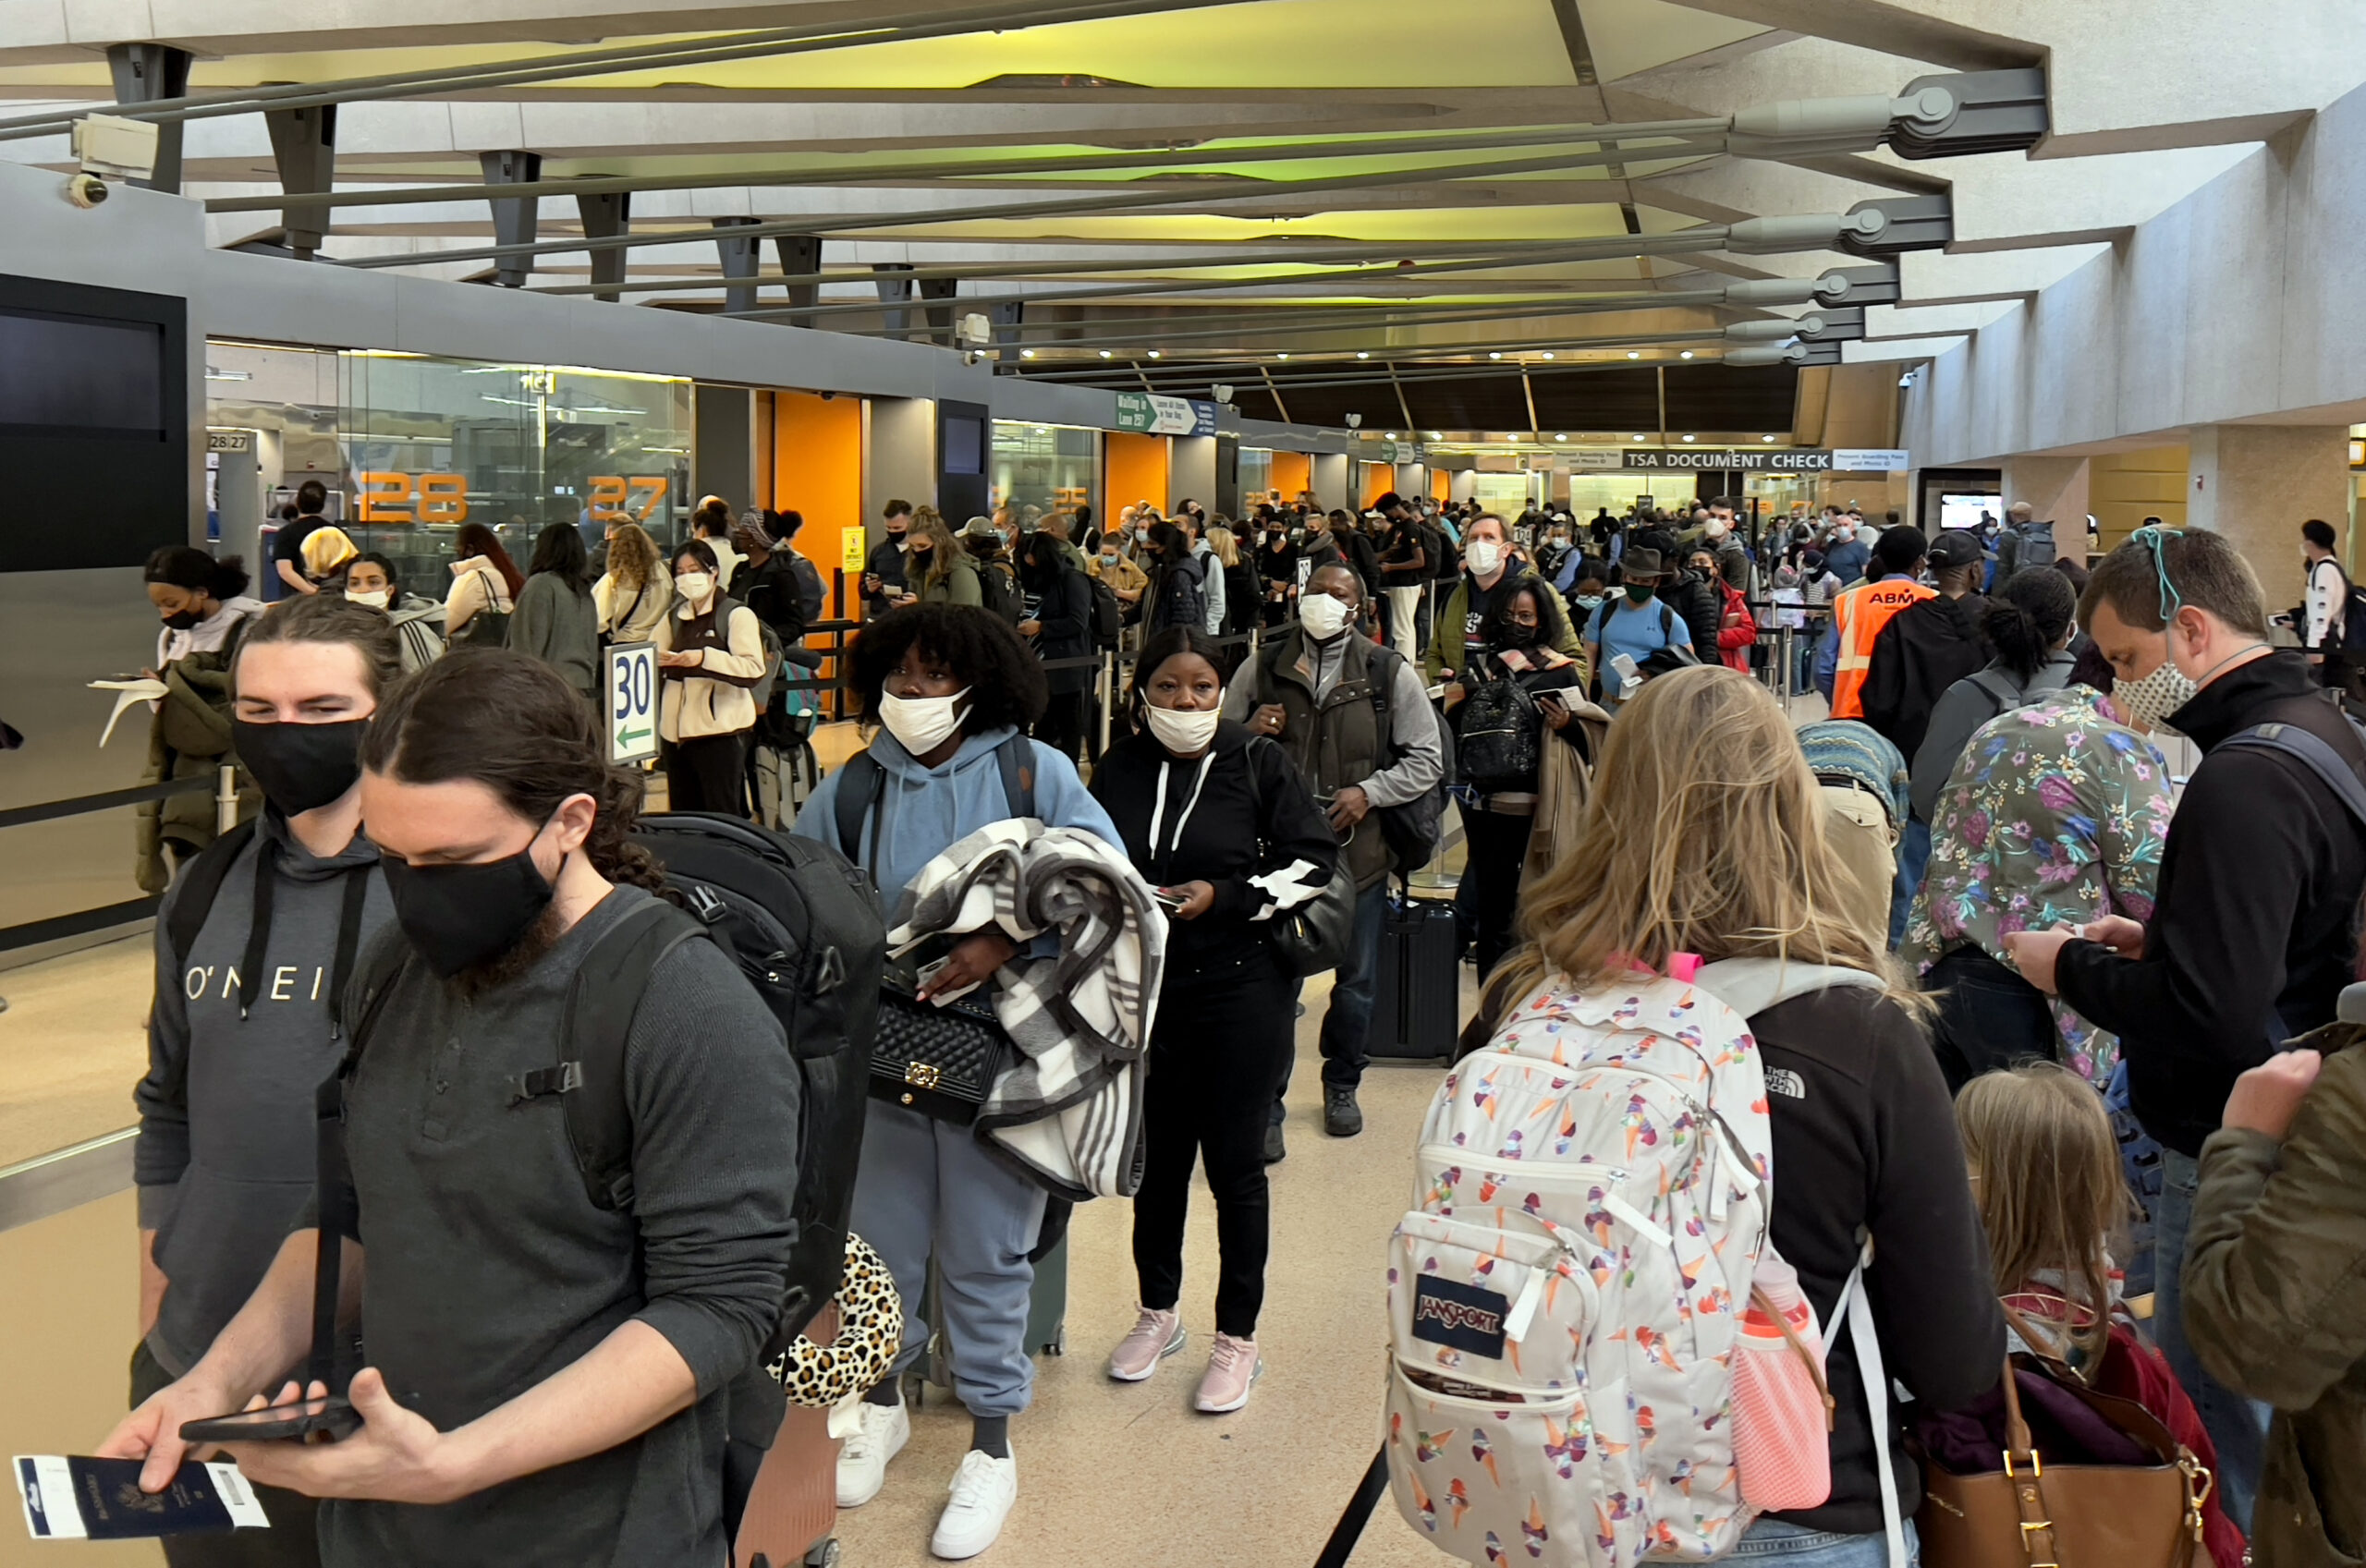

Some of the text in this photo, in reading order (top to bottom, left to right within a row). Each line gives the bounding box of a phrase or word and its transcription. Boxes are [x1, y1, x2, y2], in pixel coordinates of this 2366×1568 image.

[211, 436, 226, 448] 28
[231, 436, 246, 448] 27
[1628, 454, 1829, 468] TSA DOCUMENT CHECK
[360, 472, 468, 523] 28
[587, 476, 667, 521] 27
[1053, 487, 1088, 515] 25
[1870, 592, 1914, 604] ABM
[616, 653, 650, 720] 30
[186, 966, 323, 1000] O'NEI
[1764, 1074, 1787, 1087] RTH
[1416, 1295, 1499, 1335] JANSPORT
